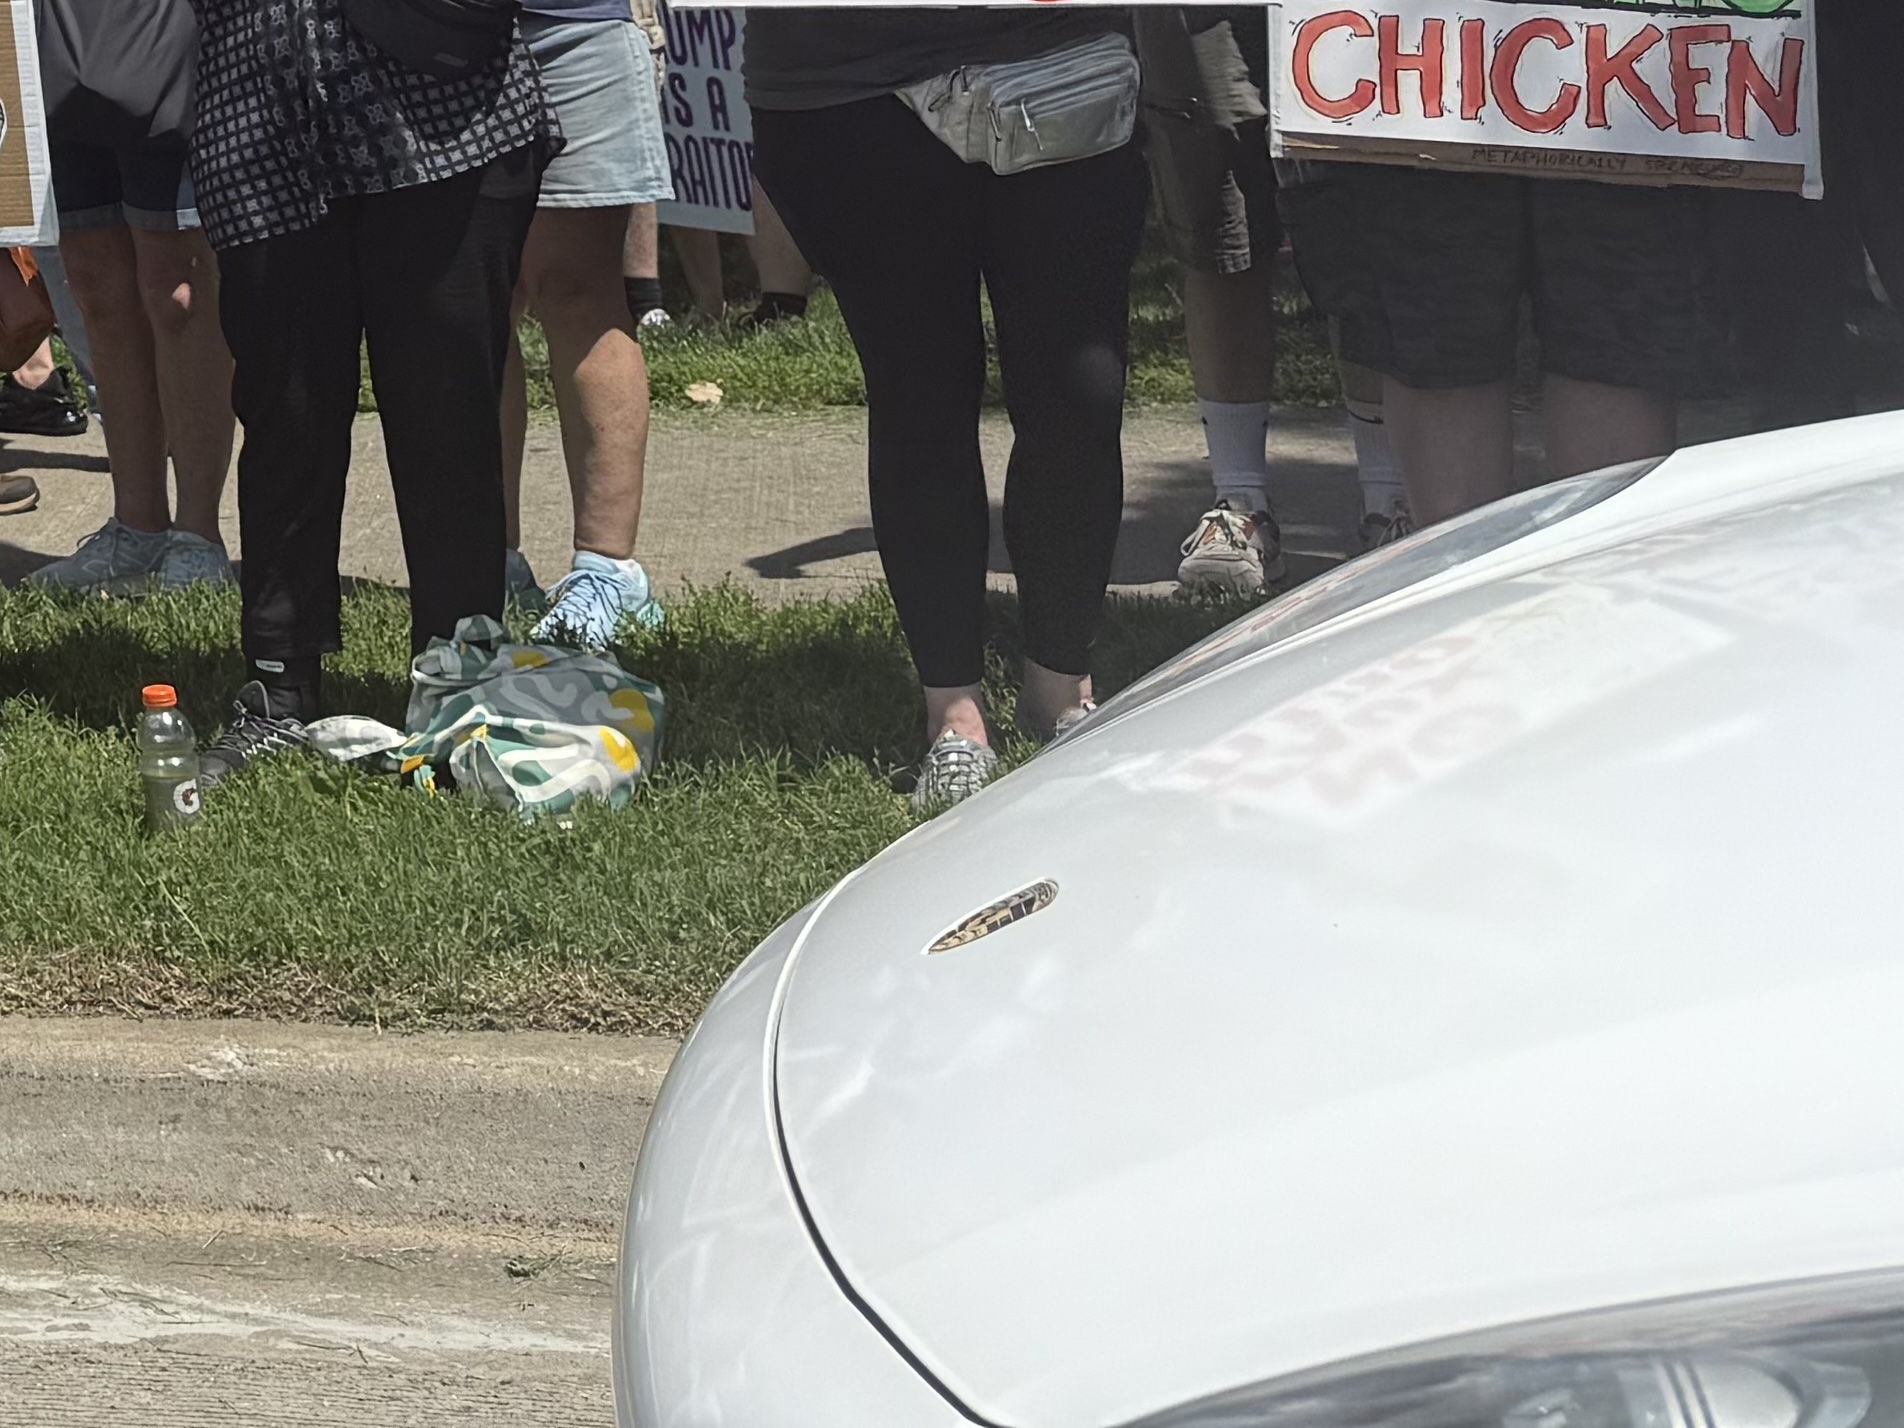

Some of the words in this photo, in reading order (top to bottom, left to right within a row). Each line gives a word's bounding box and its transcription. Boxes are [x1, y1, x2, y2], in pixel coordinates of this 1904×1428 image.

[1291, 9, 1805, 139] CHICKEN
[1470, 146, 1628, 170] METAPHORICALLY
[173, 778, 201, 815] G
